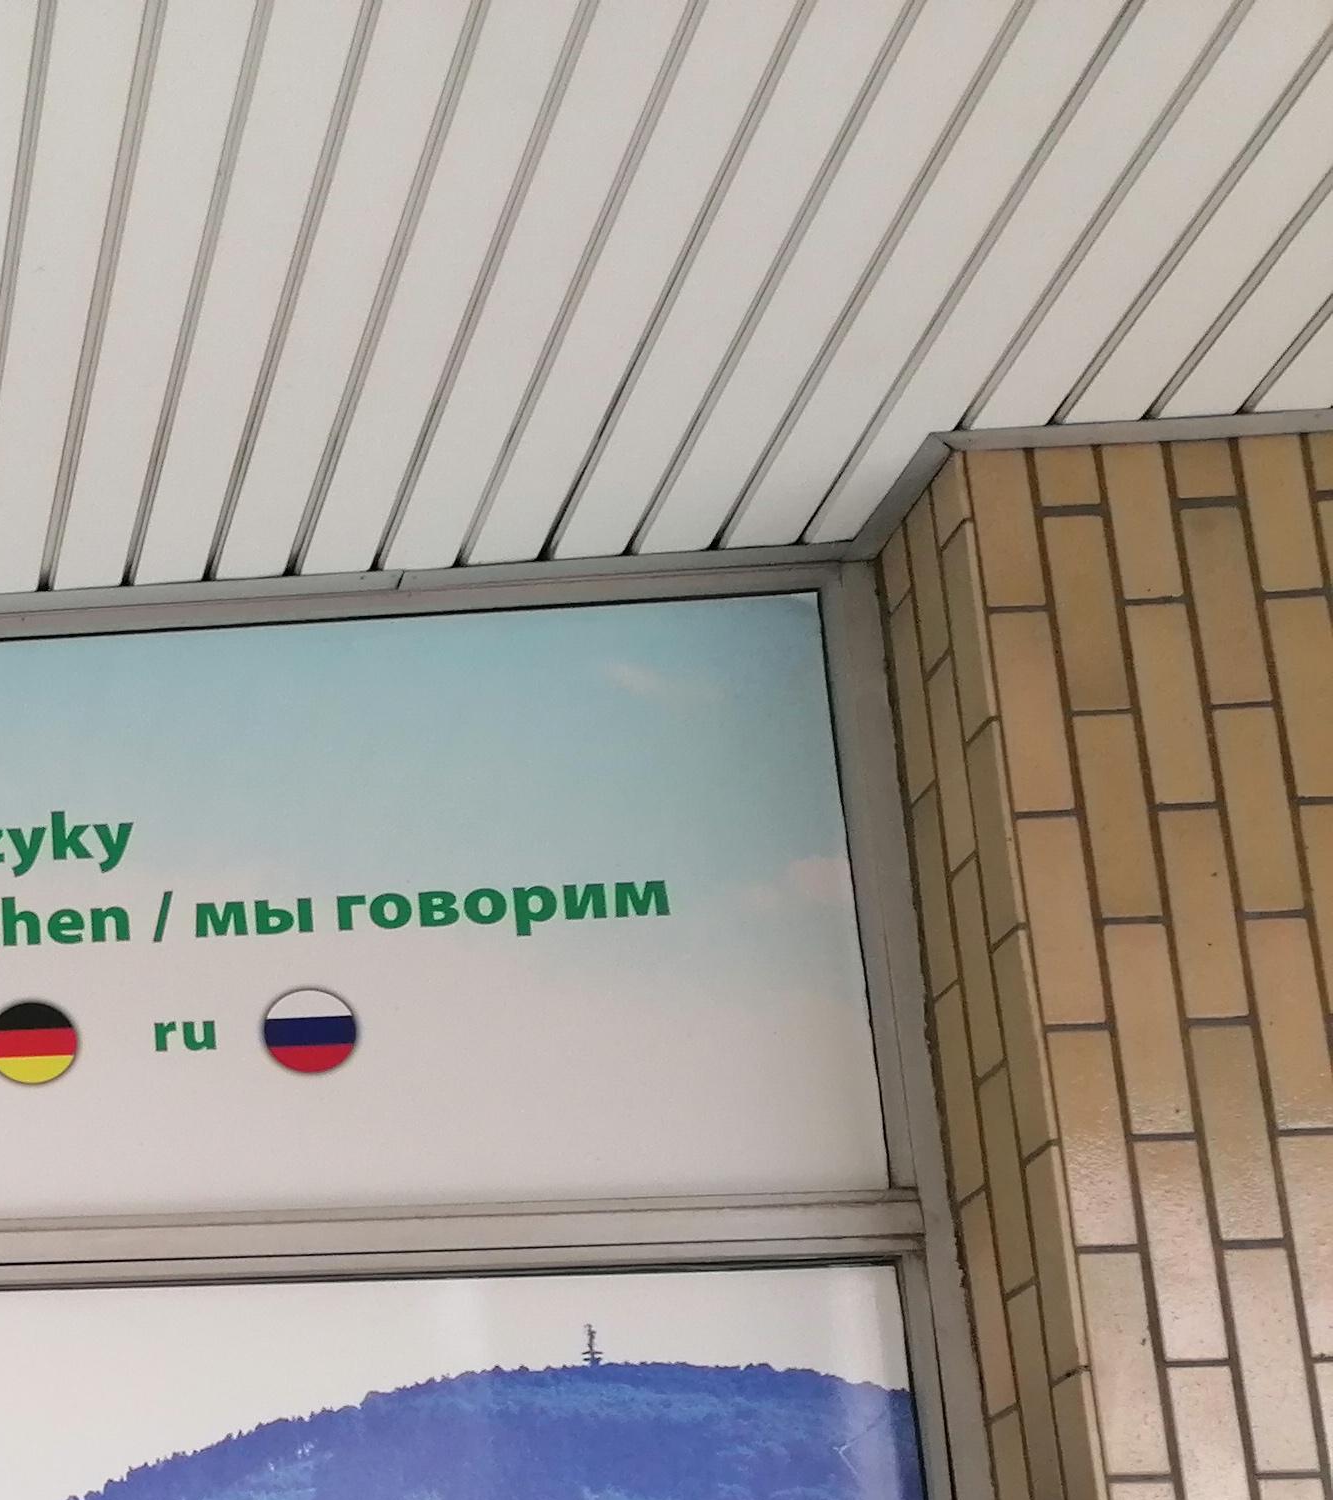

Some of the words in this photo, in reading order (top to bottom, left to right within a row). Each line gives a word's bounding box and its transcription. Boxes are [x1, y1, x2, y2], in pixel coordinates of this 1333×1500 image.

[152, 890, 173, 943] /
[194, 897, 315, 938] мы
[336, 878, 670, 936] говорим
[153, 1019, 217, 1052] ru
